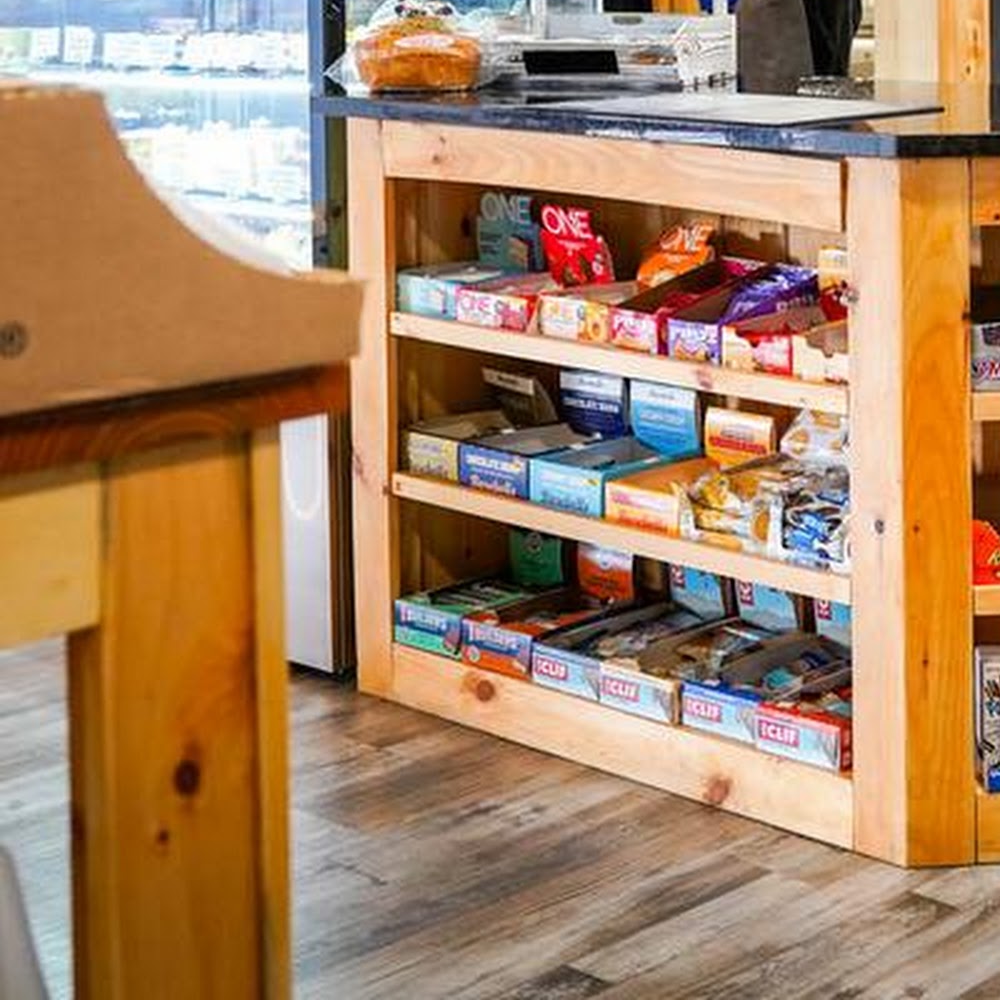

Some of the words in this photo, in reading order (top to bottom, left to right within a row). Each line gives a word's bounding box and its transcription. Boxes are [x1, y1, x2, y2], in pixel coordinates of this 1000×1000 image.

[481, 192, 532, 225] ONE
[541, 205, 594, 239] ONE
[767, 726, 798, 745] CLIF
